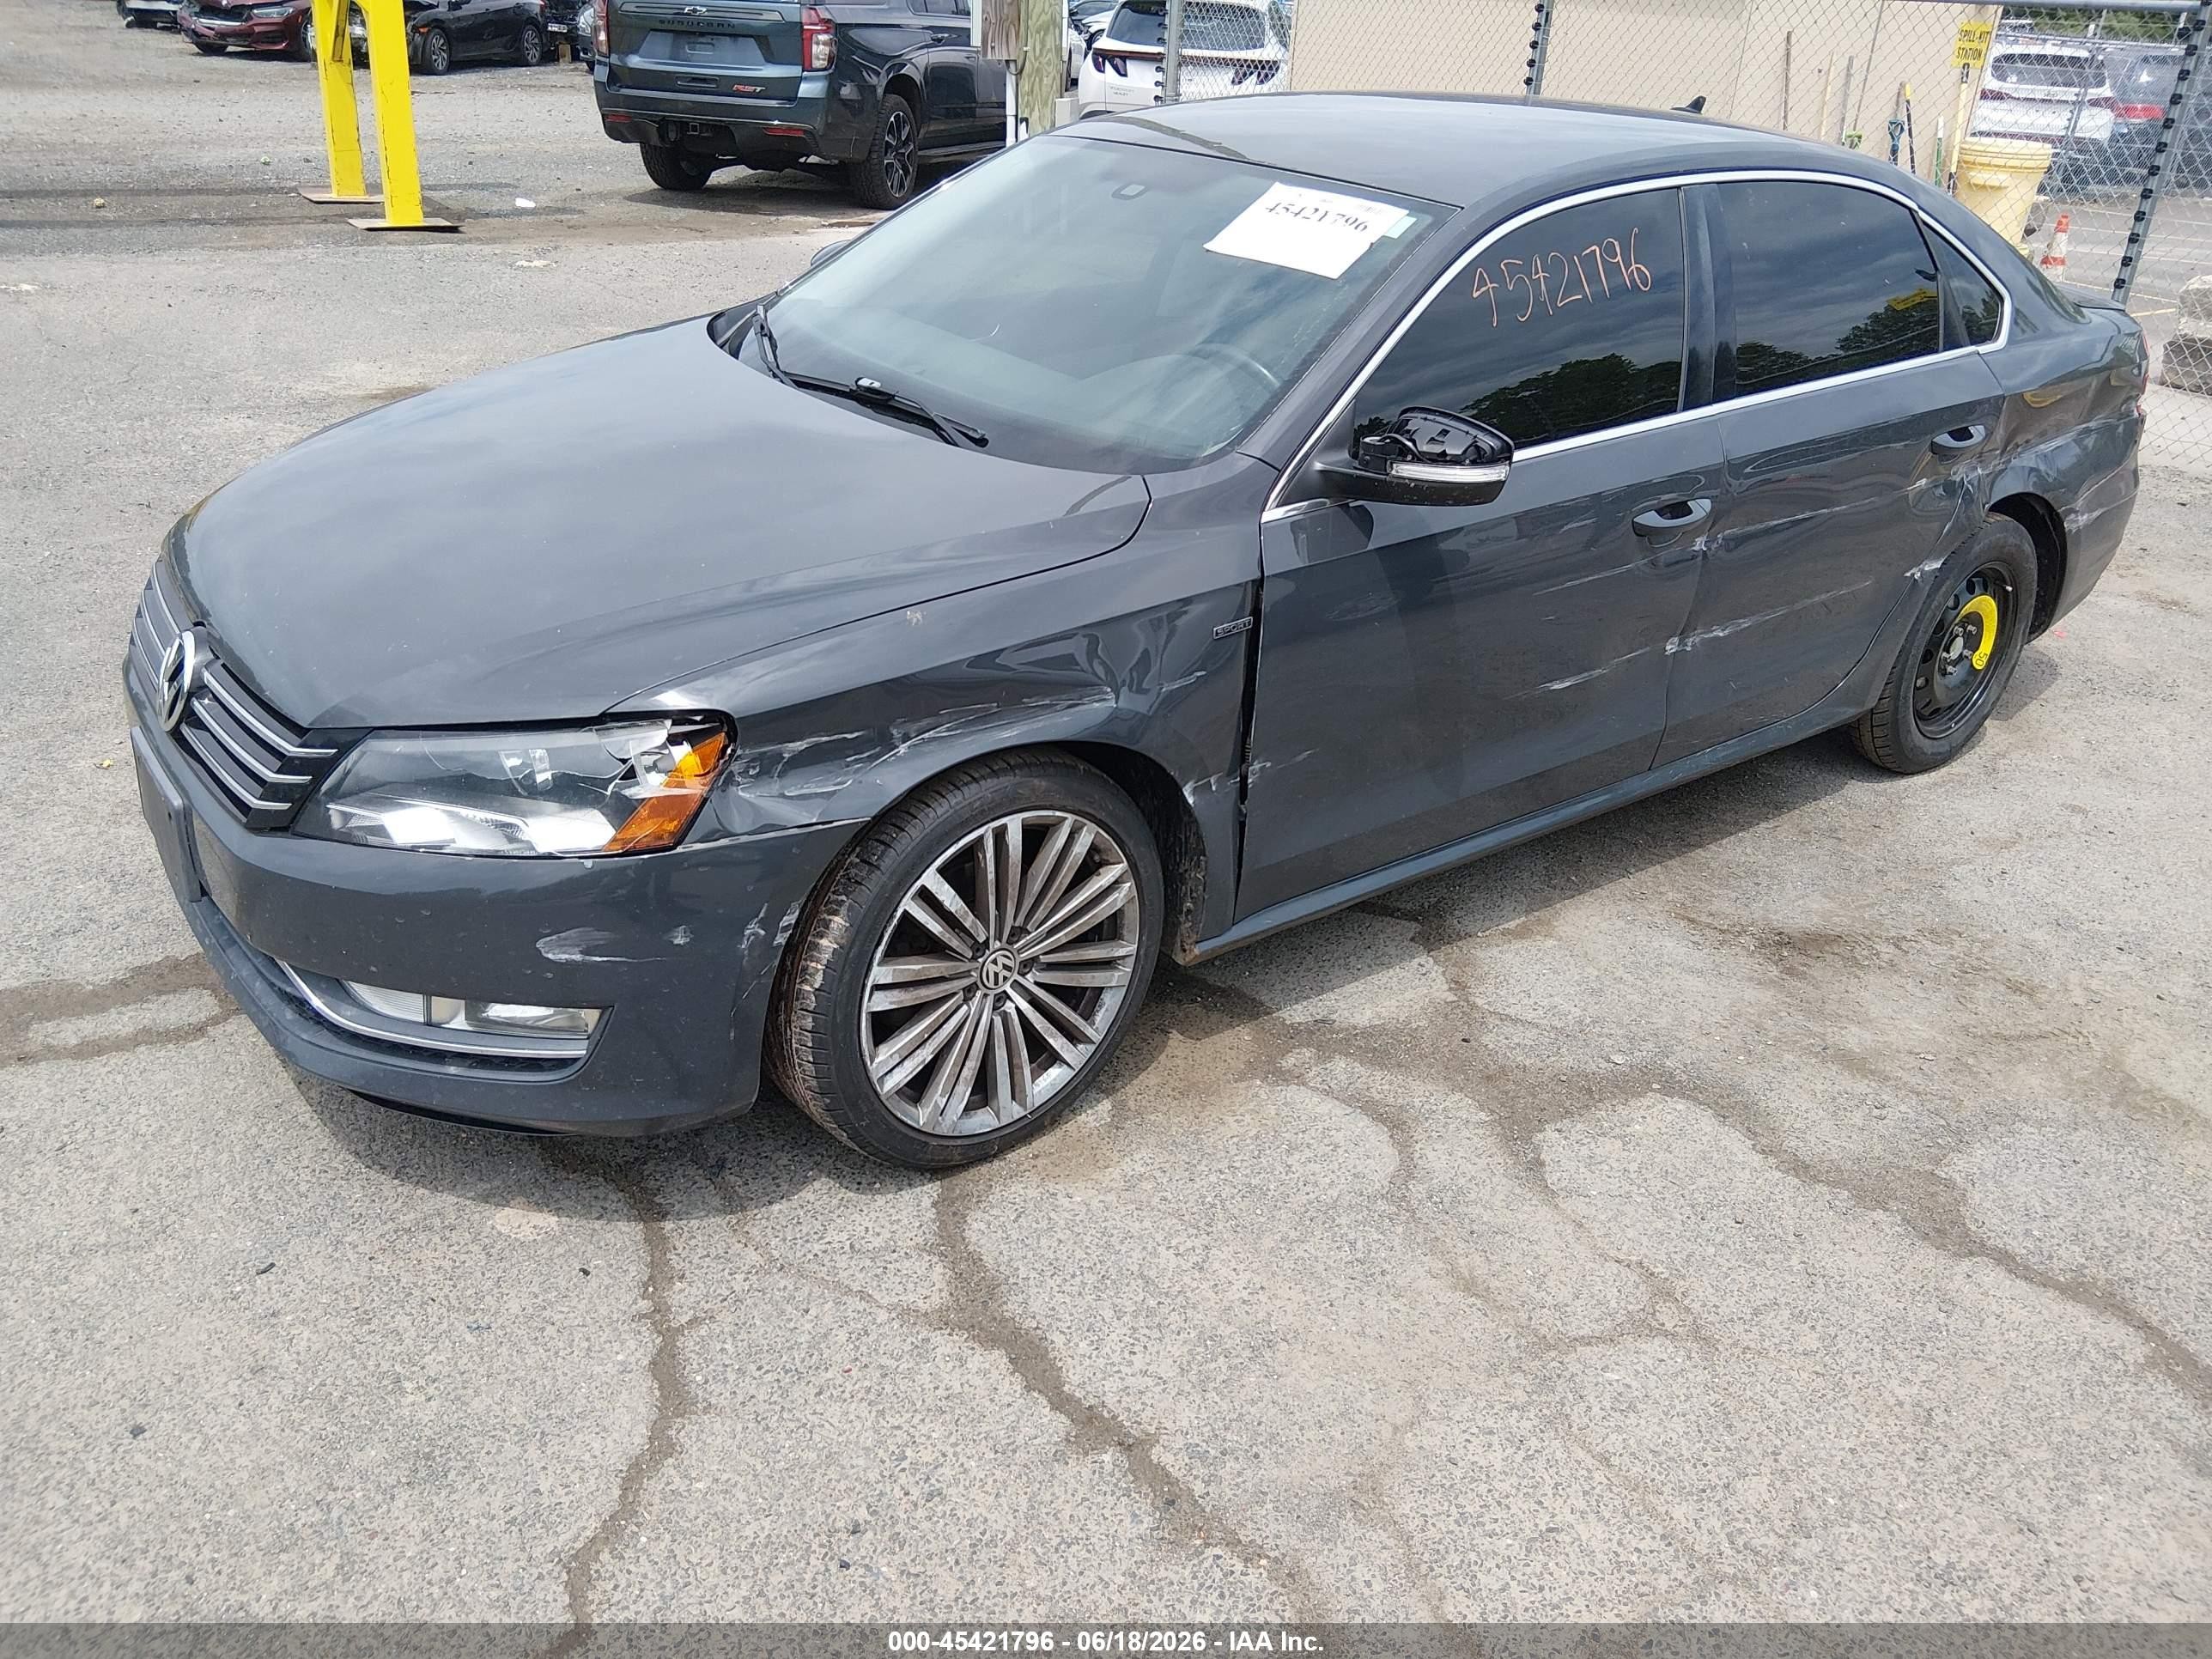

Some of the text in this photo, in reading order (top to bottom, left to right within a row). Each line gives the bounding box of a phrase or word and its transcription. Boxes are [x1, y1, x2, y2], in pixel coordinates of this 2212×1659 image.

[1956, 46, 1983, 61] STATION
[1264, 202, 1369, 232] 45421796
[1471, 227, 1652, 328] 45421796
[1217, 619, 1251, 636] SPORT
[981, 950, 1016, 989] VW
